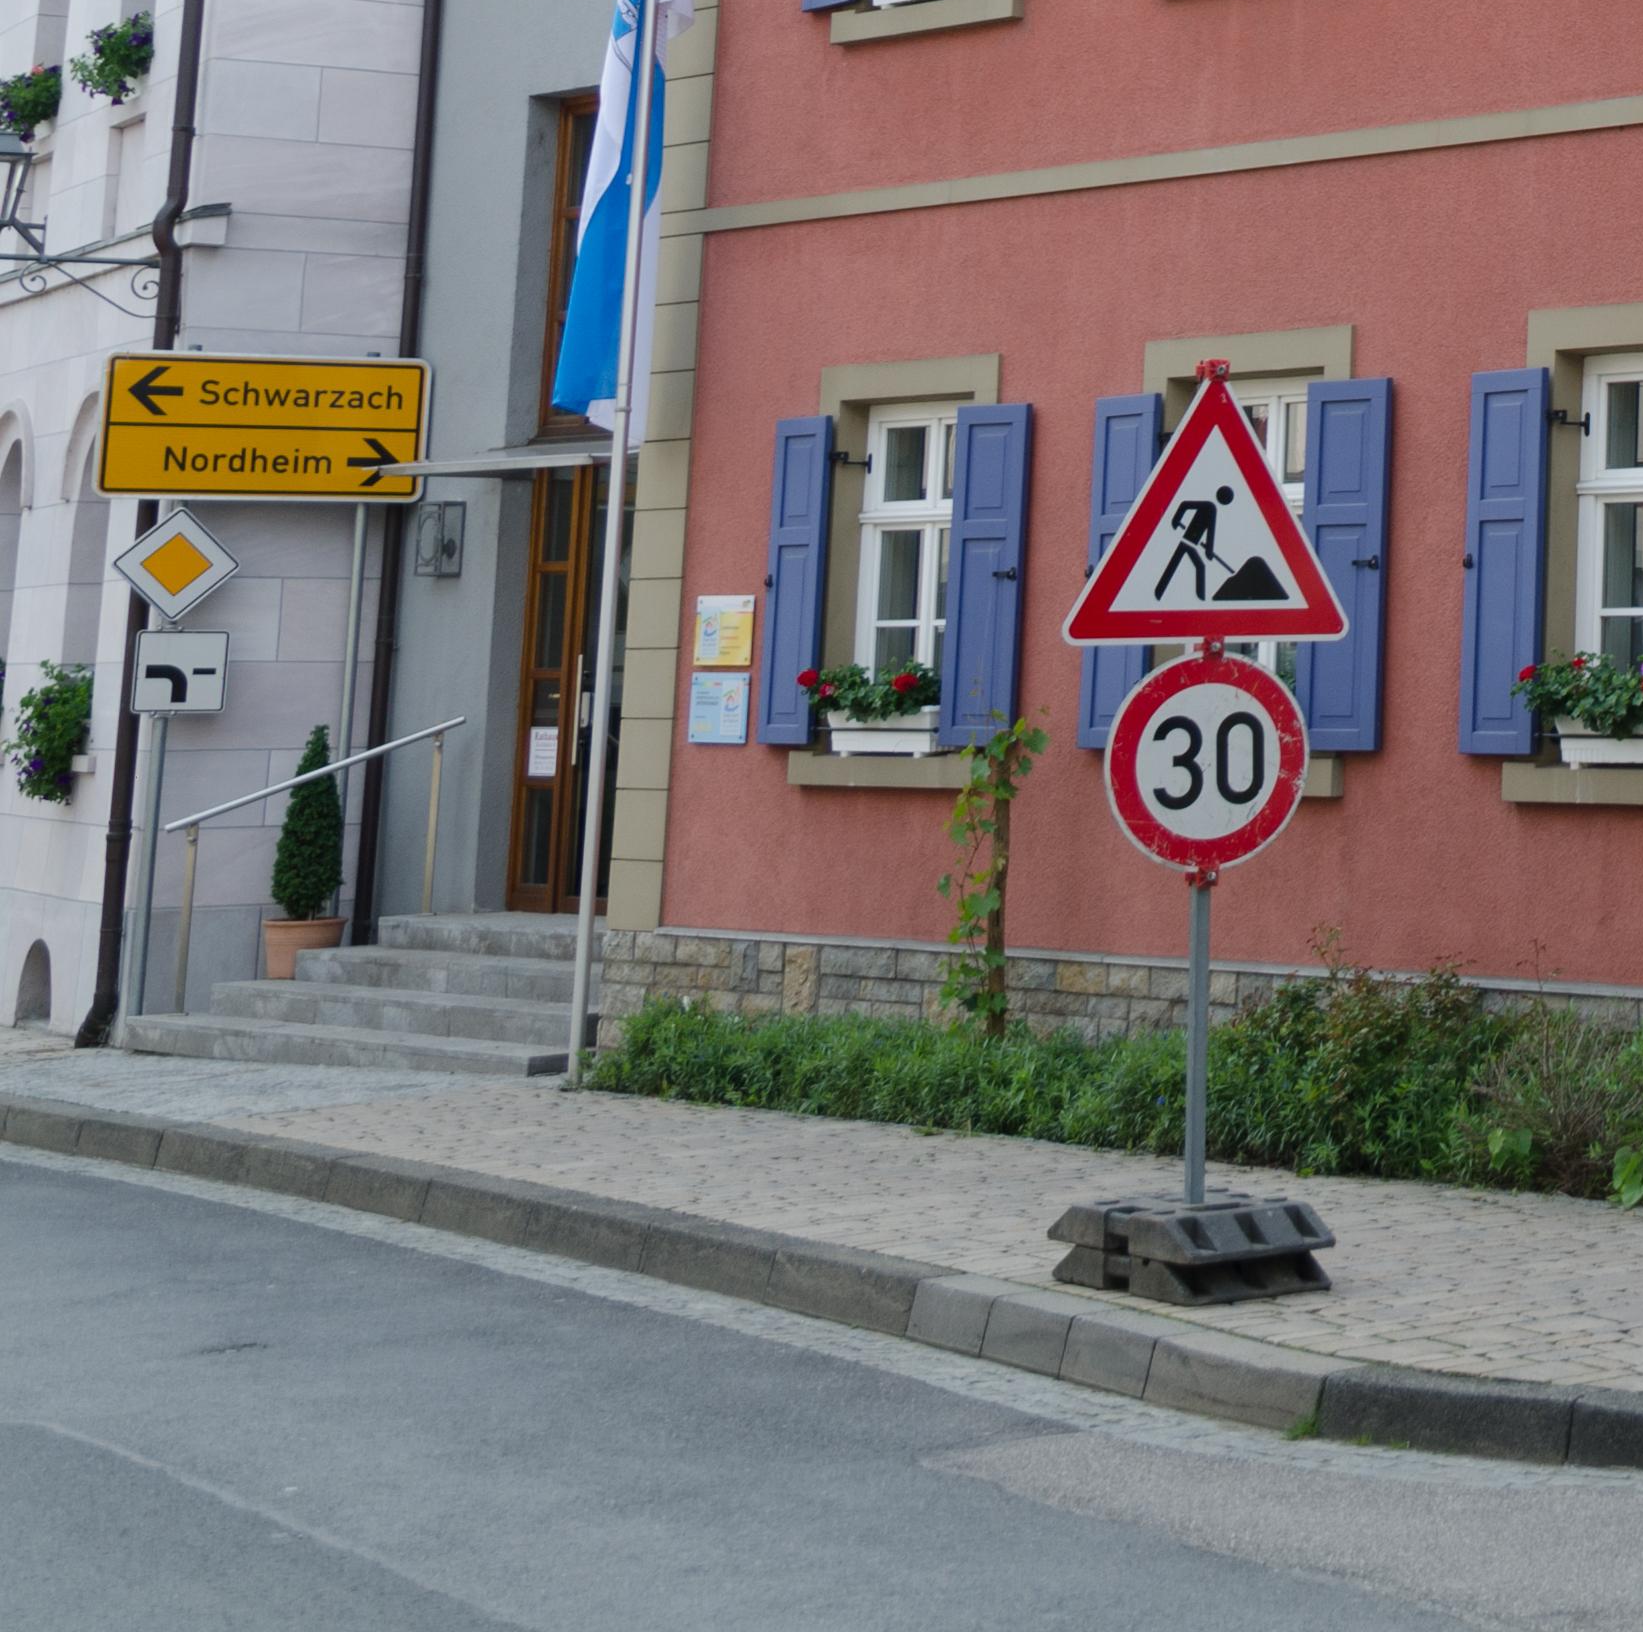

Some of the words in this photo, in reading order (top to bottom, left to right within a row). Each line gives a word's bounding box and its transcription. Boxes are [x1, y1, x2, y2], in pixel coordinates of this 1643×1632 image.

[200, 380, 403, 410] Schwarzach
[163, 446, 332, 474] Nordheim
[1153, 711, 1265, 810] 30
